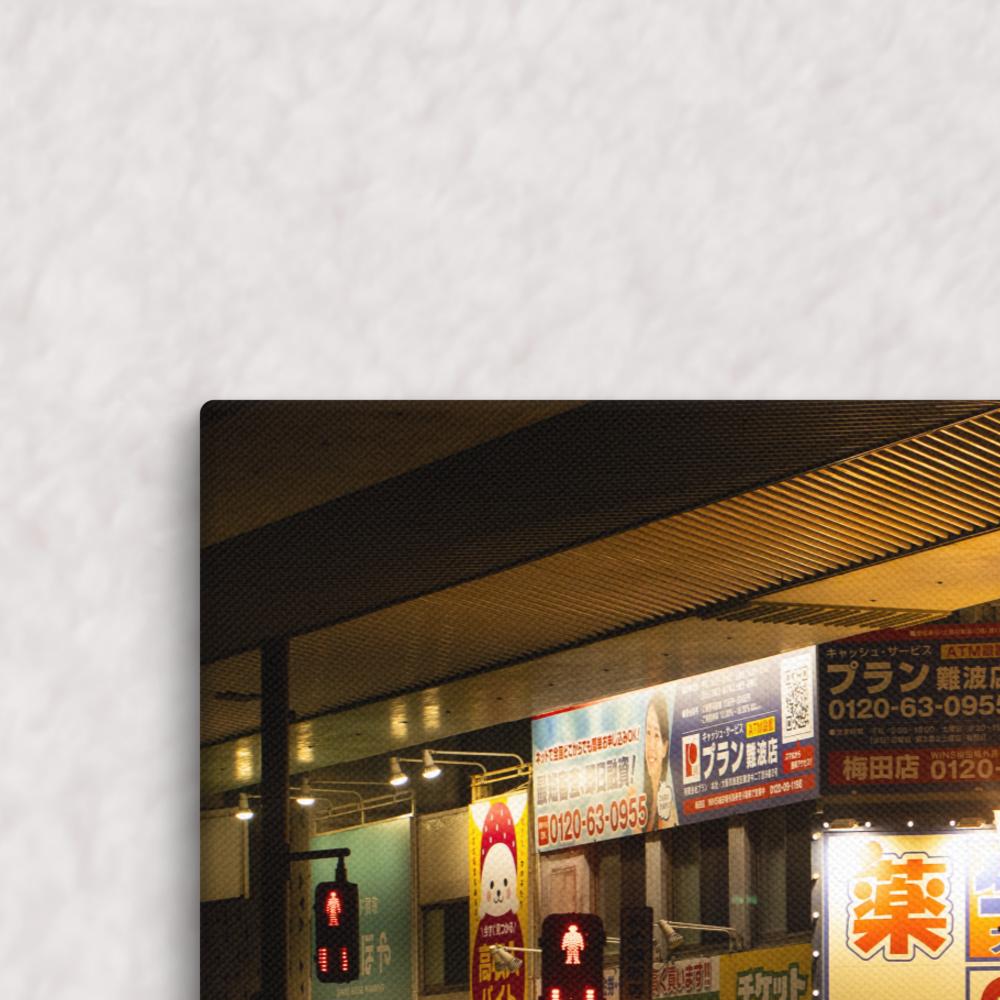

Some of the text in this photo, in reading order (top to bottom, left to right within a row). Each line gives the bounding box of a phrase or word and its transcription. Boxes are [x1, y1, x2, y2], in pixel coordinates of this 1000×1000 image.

[827, 661, 930, 695] プラン
[702, 742, 745, 780] プラン
[746, 738, 778, 769] 難波店
[843, 755, 920, 782] 梅田店
[549, 793, 648, 844] 0120-63-0955
[852, 857, 948, 956] 薬
